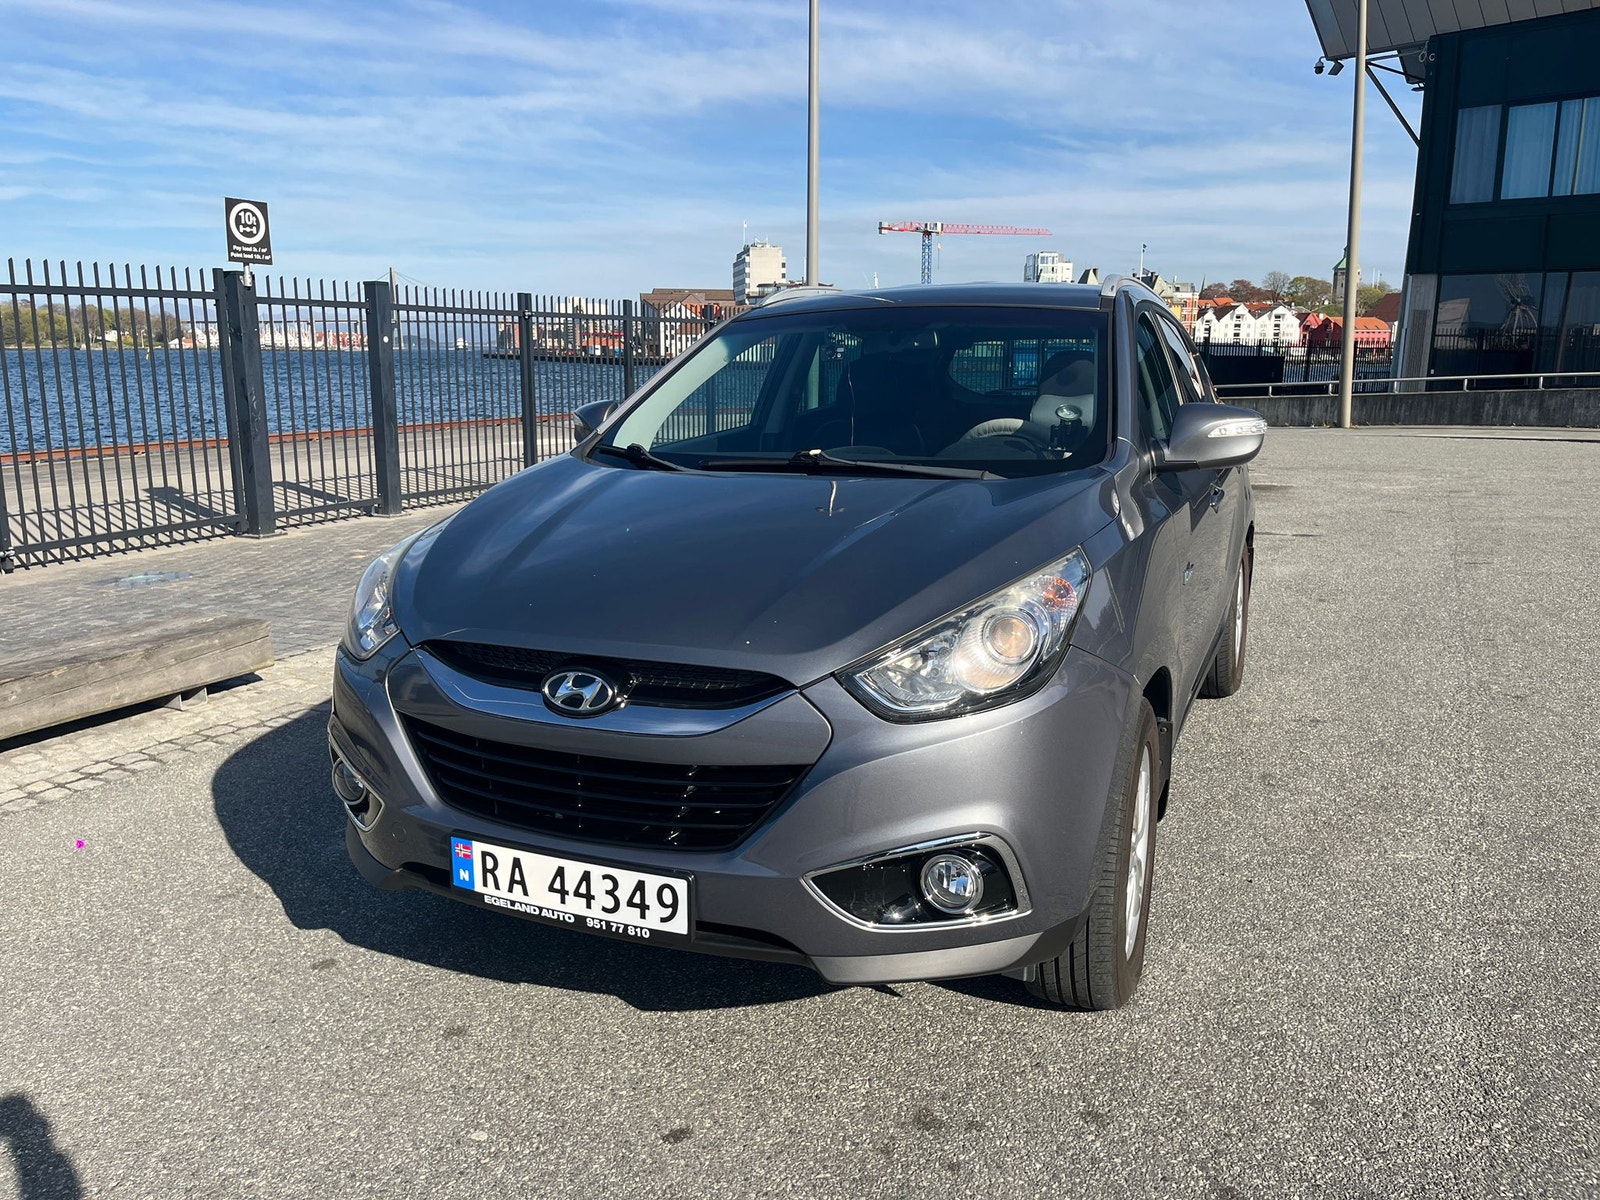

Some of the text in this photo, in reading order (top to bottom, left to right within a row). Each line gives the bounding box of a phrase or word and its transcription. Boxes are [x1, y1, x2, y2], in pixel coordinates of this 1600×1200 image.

[459, 868, 470, 882] N
[481, 850, 680, 924] RA 44349
[484, 895, 650, 938] EGELAND AUTO 951 77 810
